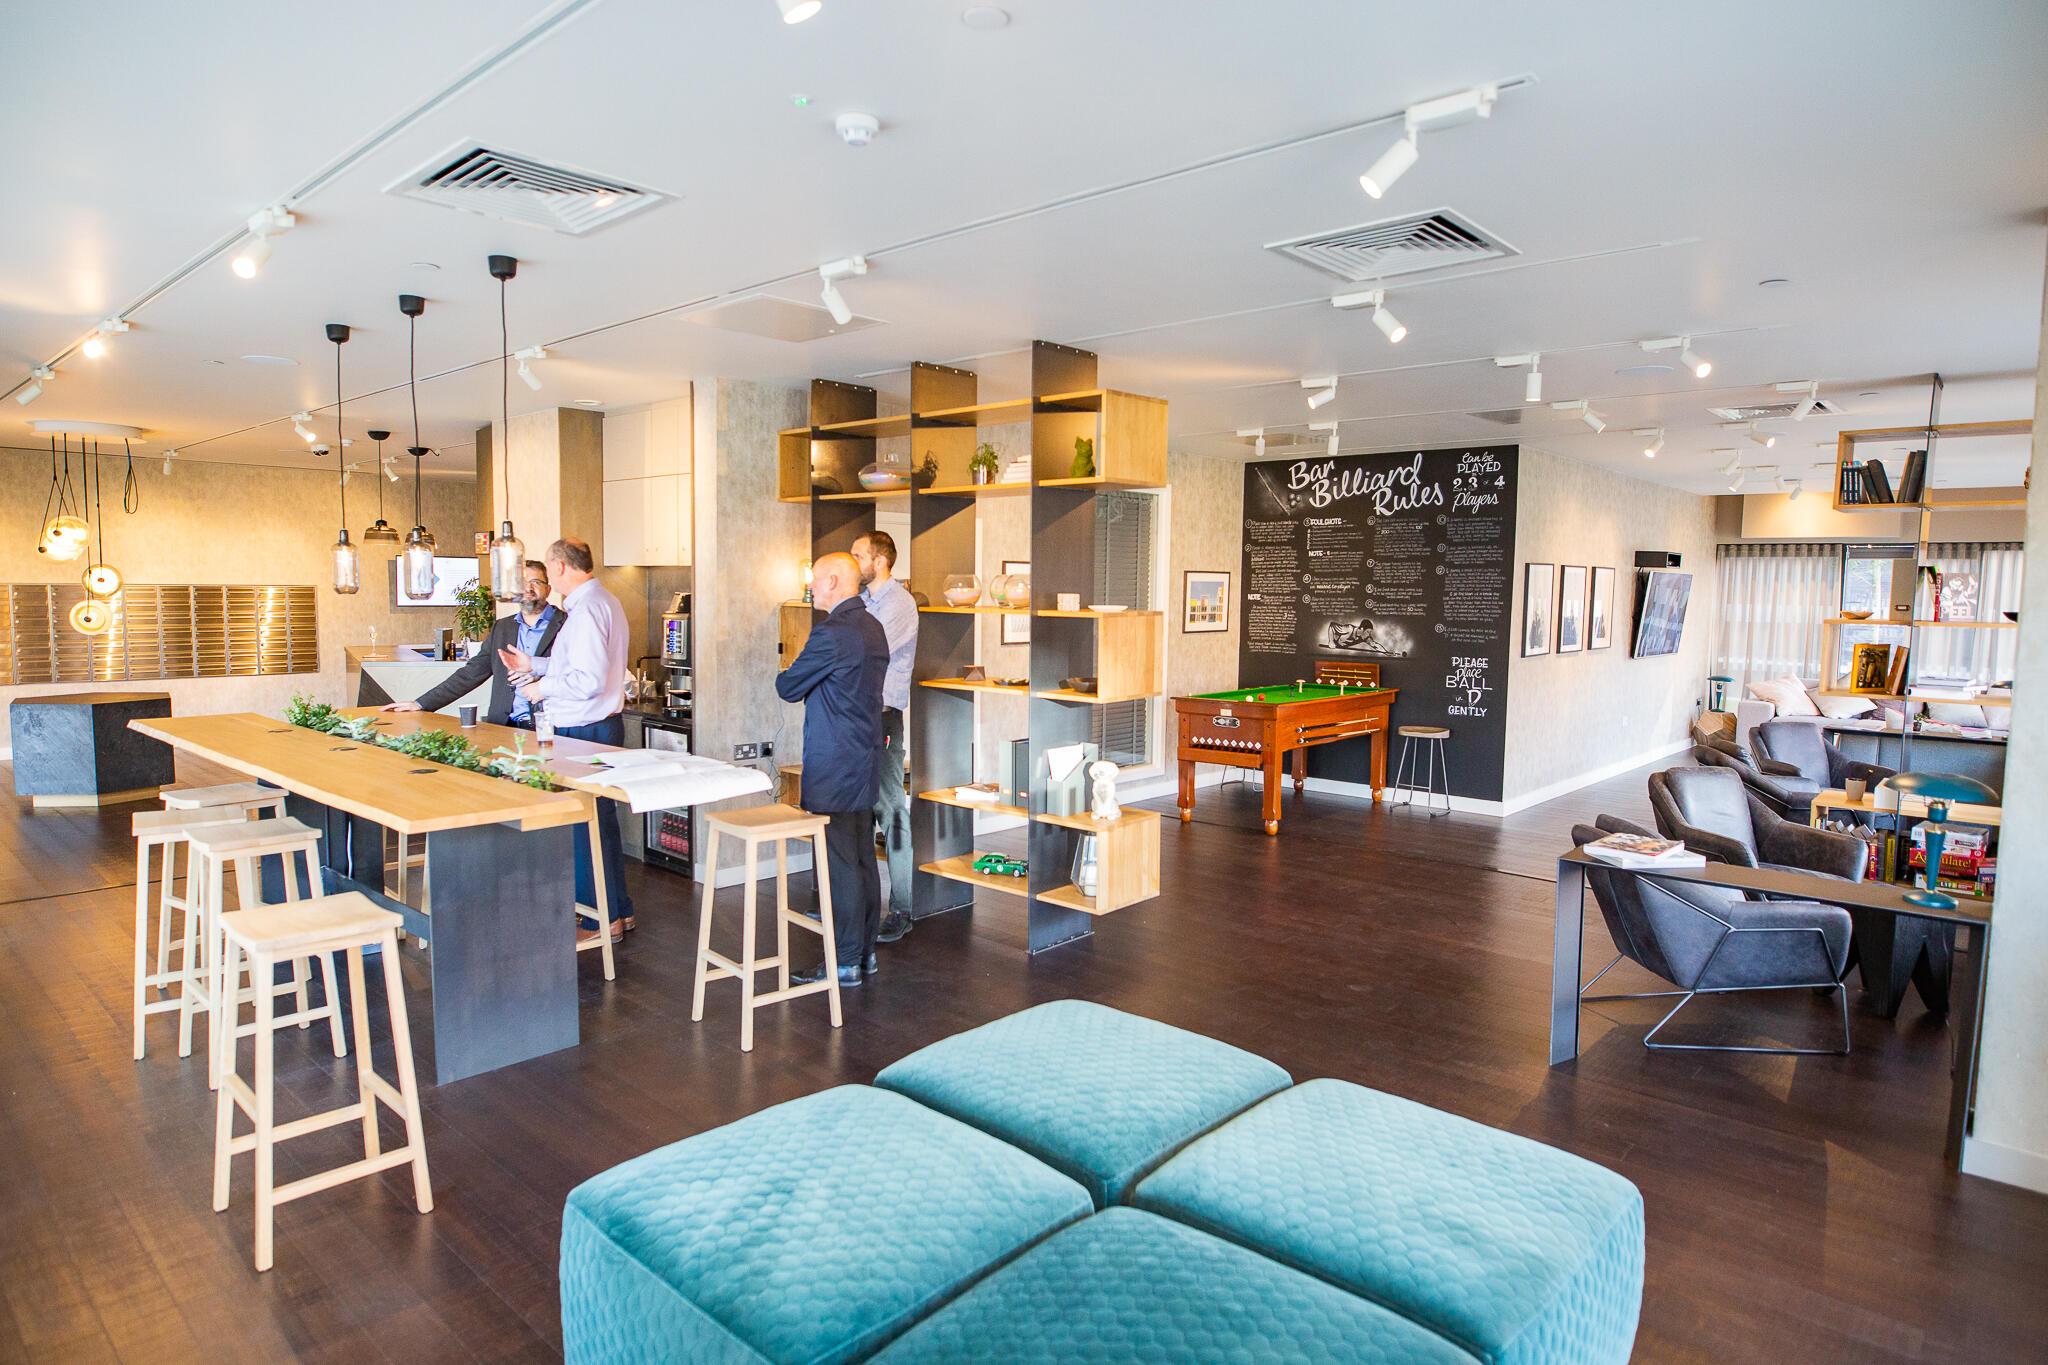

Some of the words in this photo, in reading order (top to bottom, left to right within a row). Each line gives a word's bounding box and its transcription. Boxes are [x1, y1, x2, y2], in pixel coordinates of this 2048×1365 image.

[1462, 452, 1481, 464] Can
[1482, 451, 1494, 462] be
[1288, 460, 1334, 490] Bar
[1457, 461, 1501, 474] PLAYED
[1309, 453, 1421, 507] Billiard
[1467, 476, 1479, 491] 3
[1493, 475, 1506, 490] 4
[1372, 483, 1443, 516] Rules
[1451, 656, 1489, 668] PLEASE
[1446, 675, 1493, 690] BALL
[1466, 689, 1483, 706] D
[1448, 704, 1488, 718] GENTLY
